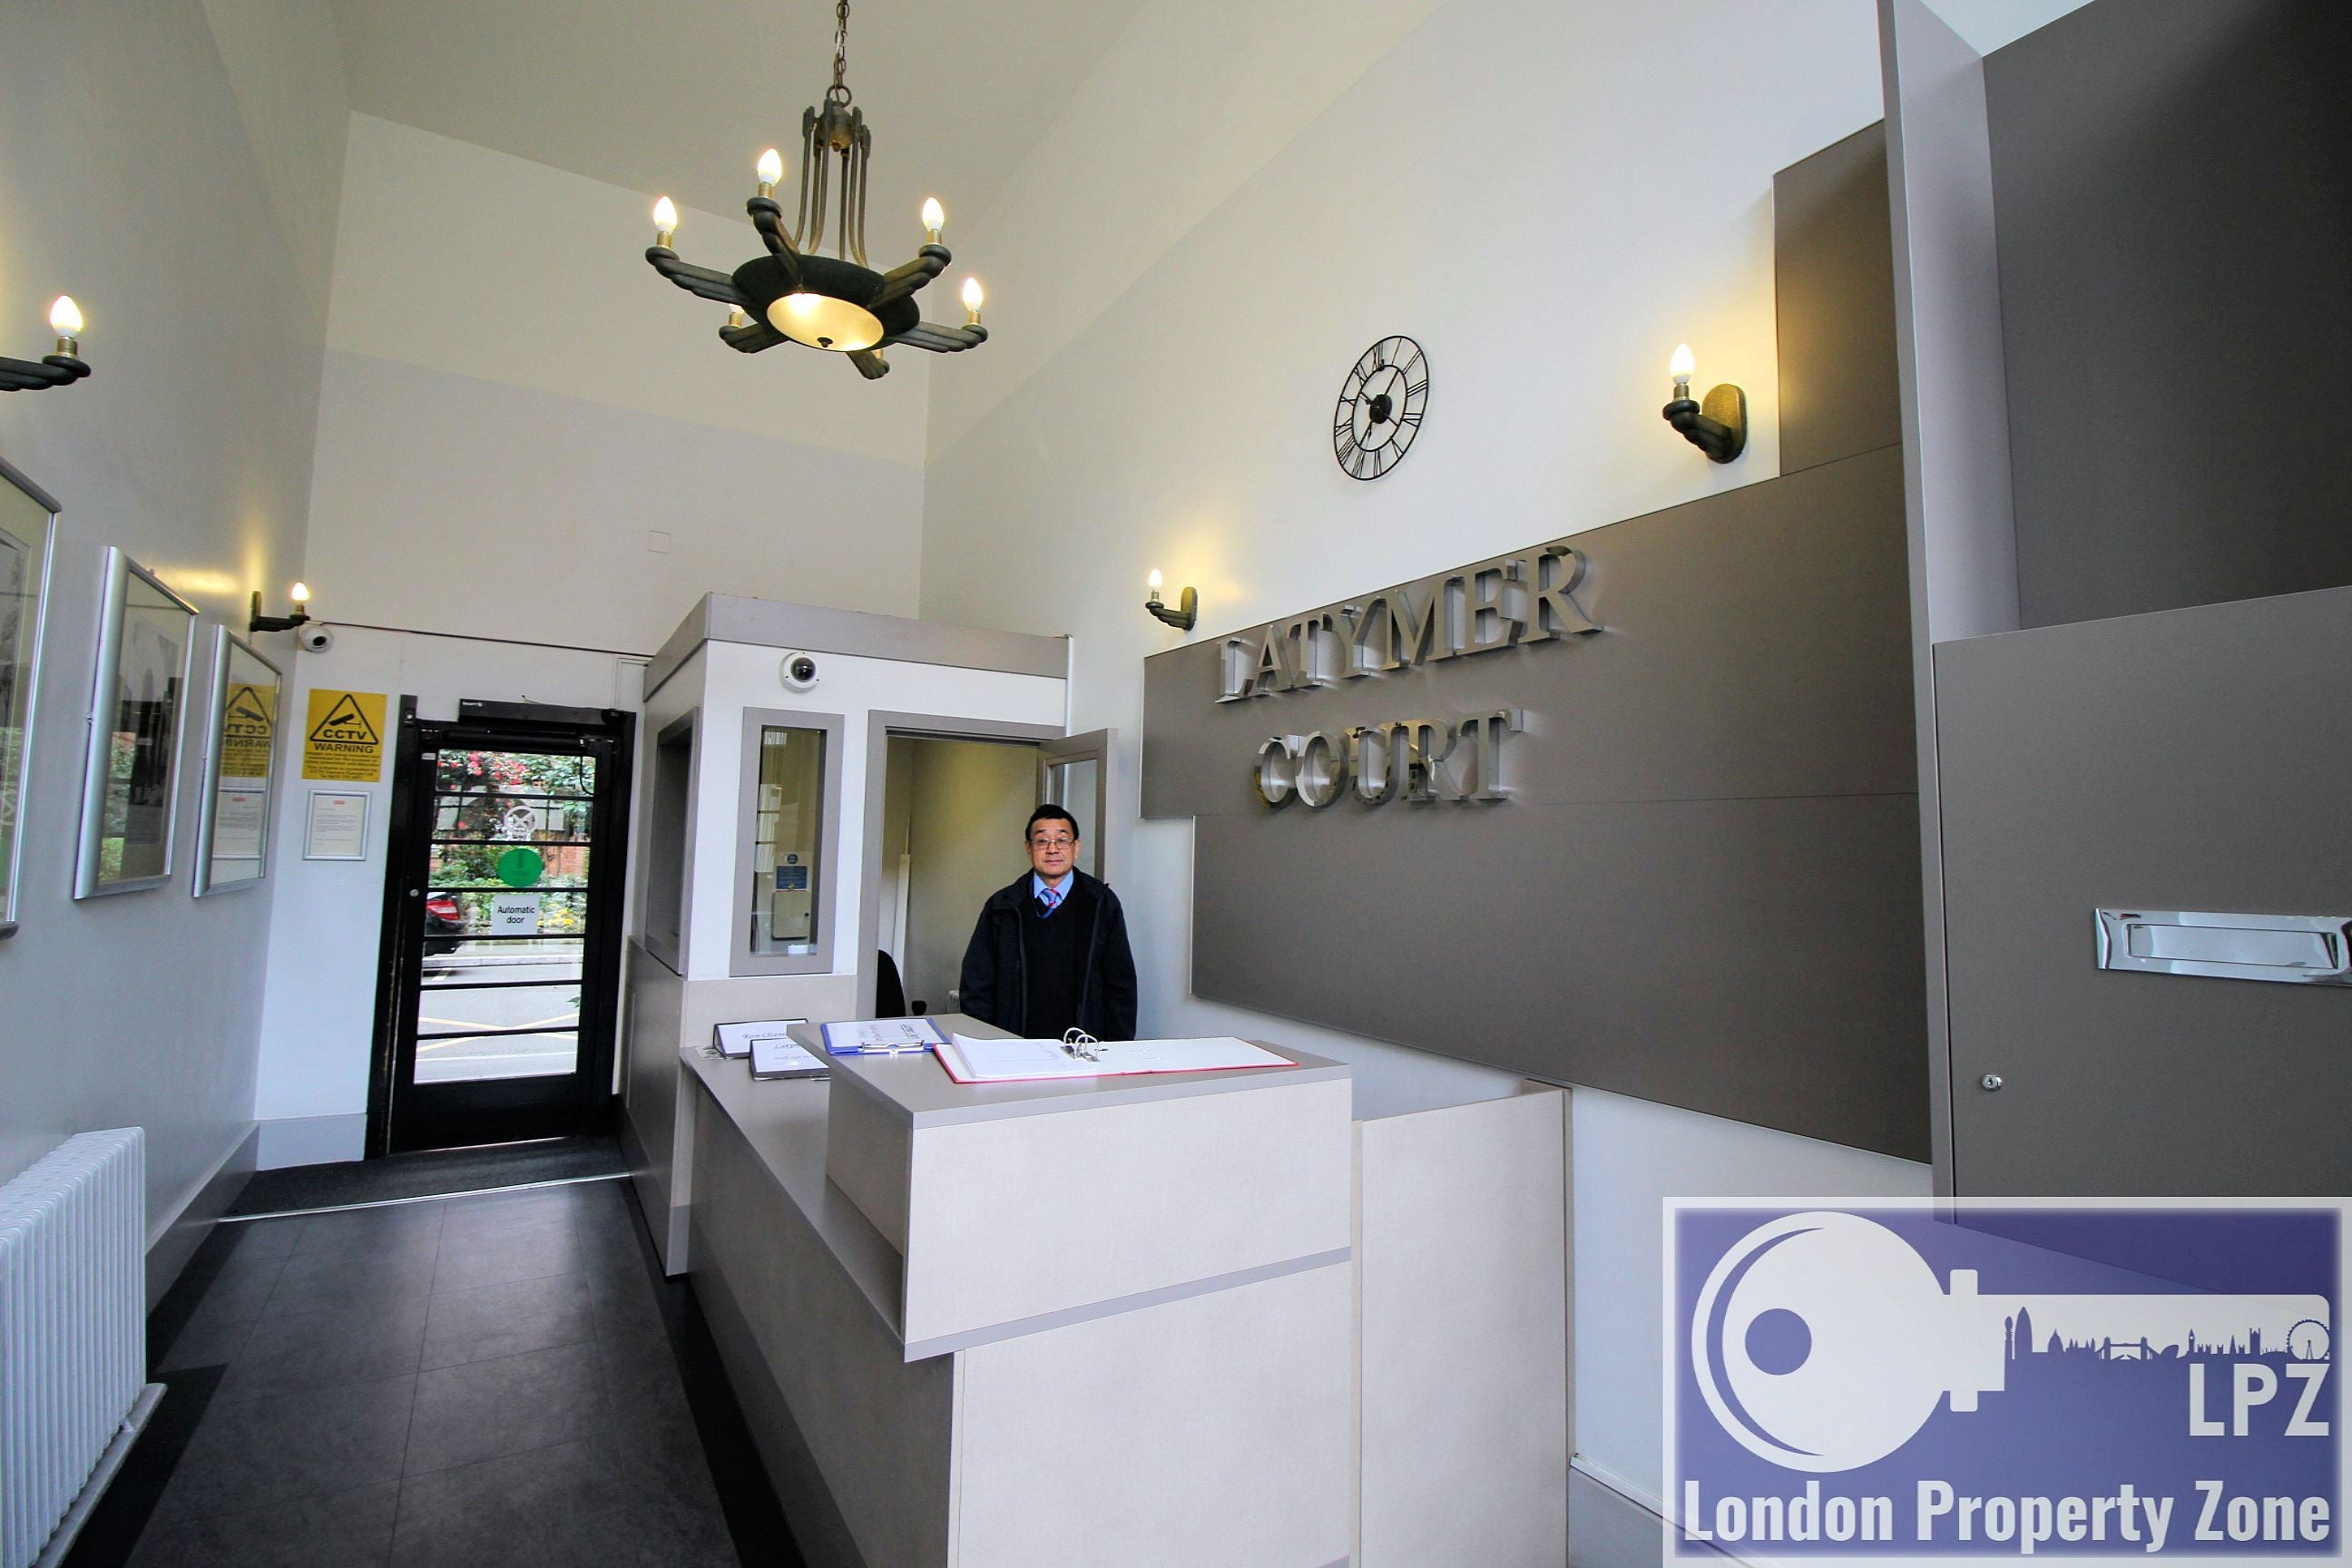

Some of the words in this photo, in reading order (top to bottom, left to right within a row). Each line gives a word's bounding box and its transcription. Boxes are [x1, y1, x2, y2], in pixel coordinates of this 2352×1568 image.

[1215, 545, 1604, 703] LATYMER
[323, 729, 368, 740] CCTV
[314, 743, 374, 753] WARNING
[1255, 708, 1523, 808] COURT
[497, 906, 536, 914] Automatic
